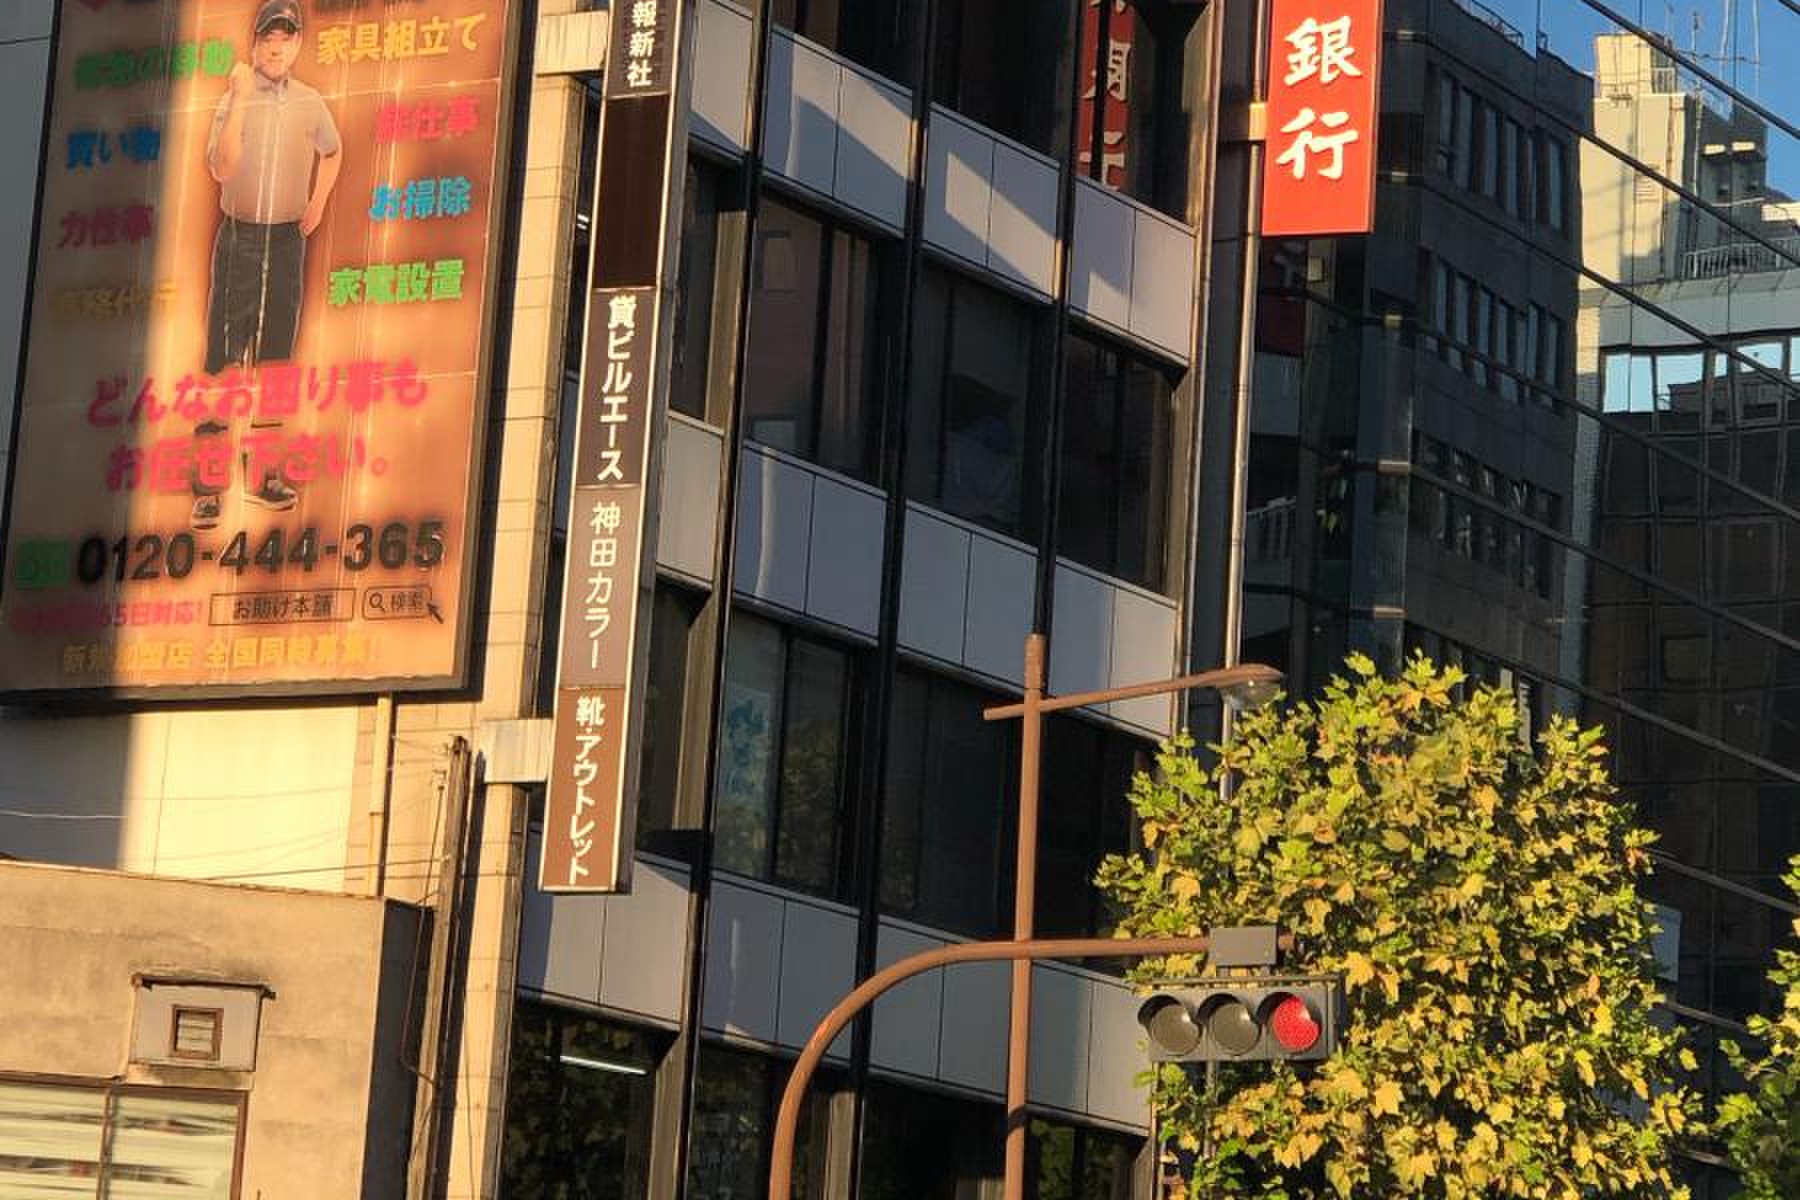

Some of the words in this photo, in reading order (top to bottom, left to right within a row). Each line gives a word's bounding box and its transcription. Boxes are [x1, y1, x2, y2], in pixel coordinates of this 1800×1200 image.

[317, 13, 487, 65] 家具組立て
[368, 175, 472, 222] お掃除
[327, 258, 465, 308] 家電設置
[597, 295, 637, 481] 貸ビルエース
[77, 520, 447, 585] 0120-444-365
[584, 502, 621, 670] 神田カラー
